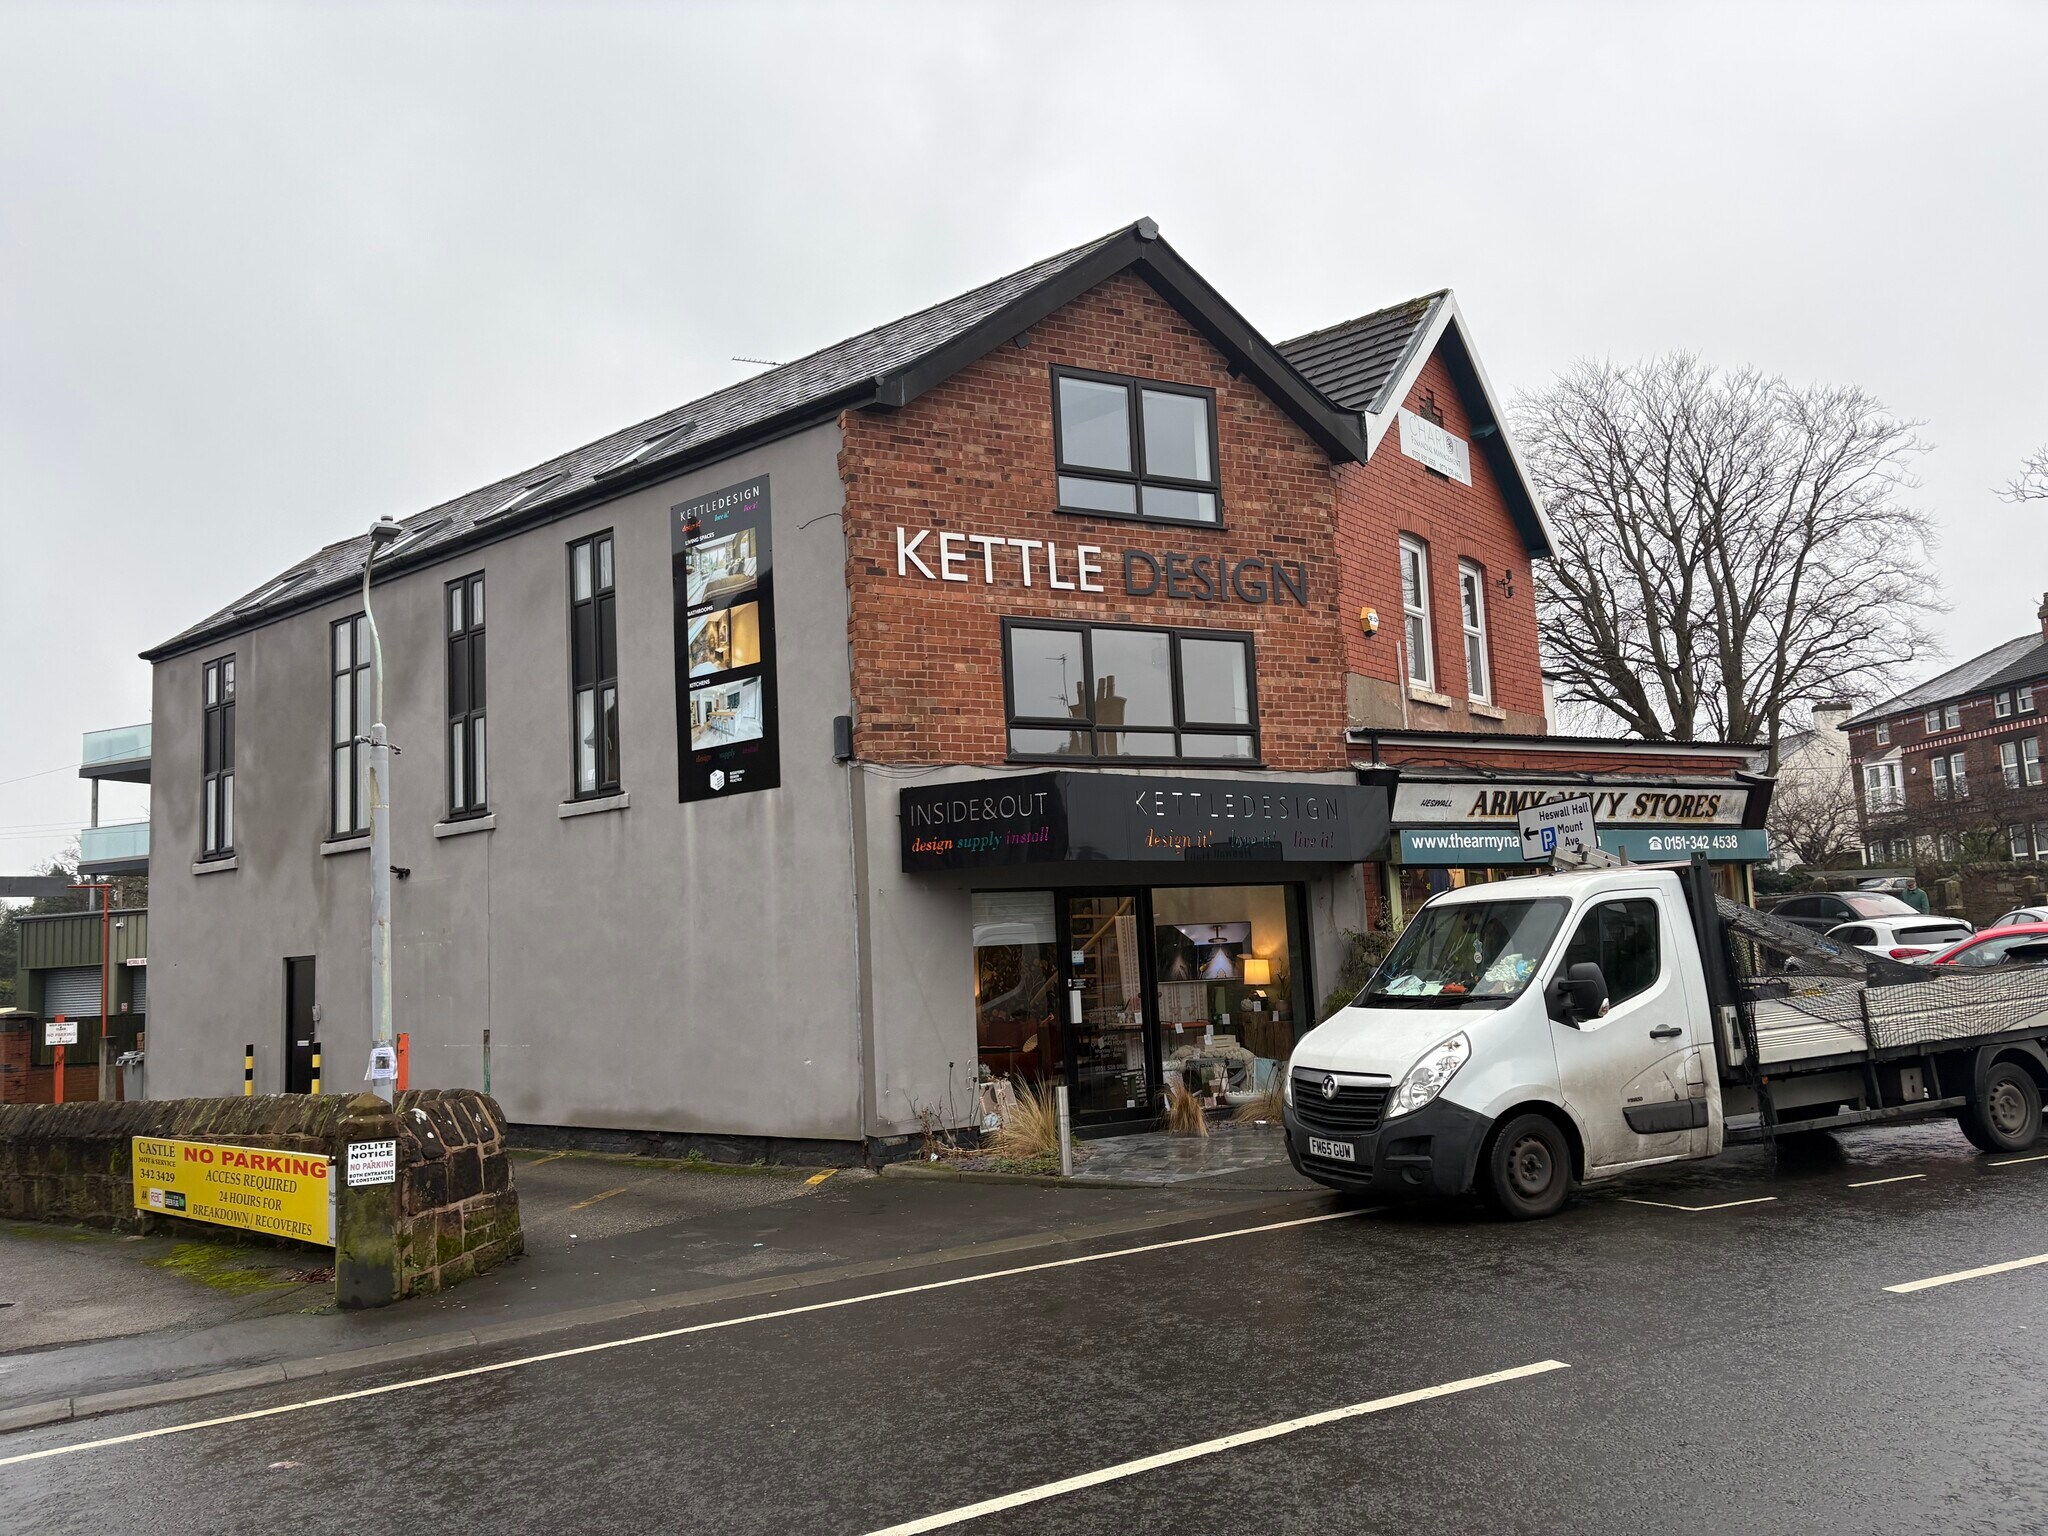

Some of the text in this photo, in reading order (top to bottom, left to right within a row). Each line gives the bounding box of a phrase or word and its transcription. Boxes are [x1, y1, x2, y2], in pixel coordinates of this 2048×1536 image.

[1409, 416, 1459, 458] CHARIOT
[680, 486, 760, 522] KETTLEDESIGN
[685, 531, 715, 546] LIVING SPACES
[896, 526, 1308, 606] KETTLE DESIGN
[687, 605, 714, 617] BATHROOMS
[689, 679, 711, 689] KITCHENS
[910, 792, 1048, 827] INSIDE&OUT
[1135, 790, 1339, 821] KETTLEDESIGN
[1420, 799, 1453, 808] HESWALL
[1538, 801, 1589, 821] Heswall Hall
[1632, 793, 1721, 819] STORES
[1557, 820, 1584, 835] Mount
[911, 826, 1049, 855] design supply install
[1144, 828, 1192, 855] design
[1197, 828, 1214, 849] it!
[1231, 829, 1258, 849] love
[1261, 829, 1277, 849] it!
[1292, 830, 1317, 849] live
[1320, 831, 1335, 849] it!
[1411, 833, 1520, 852] www.thearmyna
[1564, 836, 1580, 847] Ave
[1664, 834, 1738, 850] 0151-342 4538
[138, 1142, 176, 1158] CASTLE
[351, 1150, 393, 1159] NOTICE
[352, 1142, 393, 1151] POLITE
[1333, 1144, 1351, 1158] GUW
[138, 1156, 151, 1164] MOT
[155, 1159, 176, 1168] SERVICE
[184, 1147, 327, 1179] NO PARKING
[362, 1161, 393, 1169] PARKING
[140, 1168, 176, 1183] 342 3429
[205, 1169, 298, 1194] ACCESS REQUIRED
[219, 1190, 282, 1211] 24 HOURS FOR
[192, 1203, 250, 1224] BREAKDOWN
[255, 1214, 312, 1236] RECOVERIES
